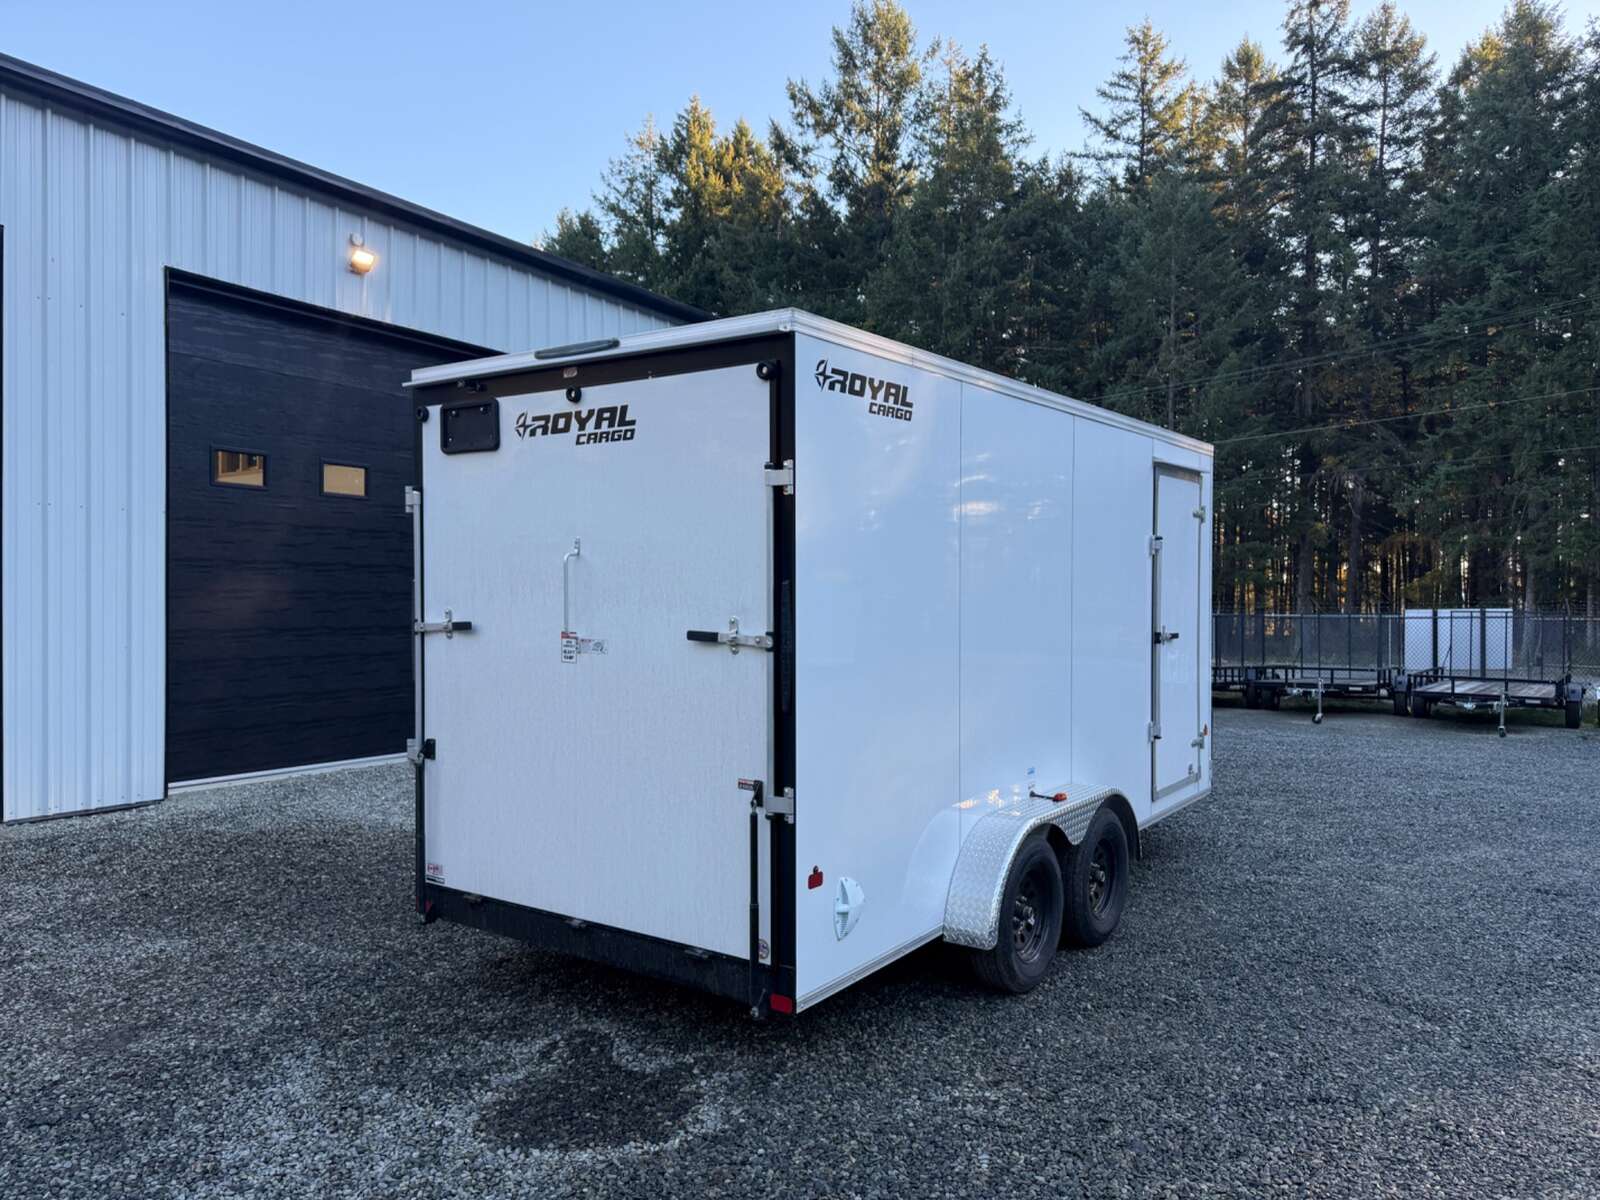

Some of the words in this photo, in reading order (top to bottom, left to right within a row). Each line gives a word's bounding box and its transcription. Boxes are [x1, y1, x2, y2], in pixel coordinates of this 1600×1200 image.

[828, 367, 913, 408] ROYAL
[529, 404, 637, 437] ROYAL
[869, 402, 913, 422] CARGO
[576, 428, 636, 445] CARGO
